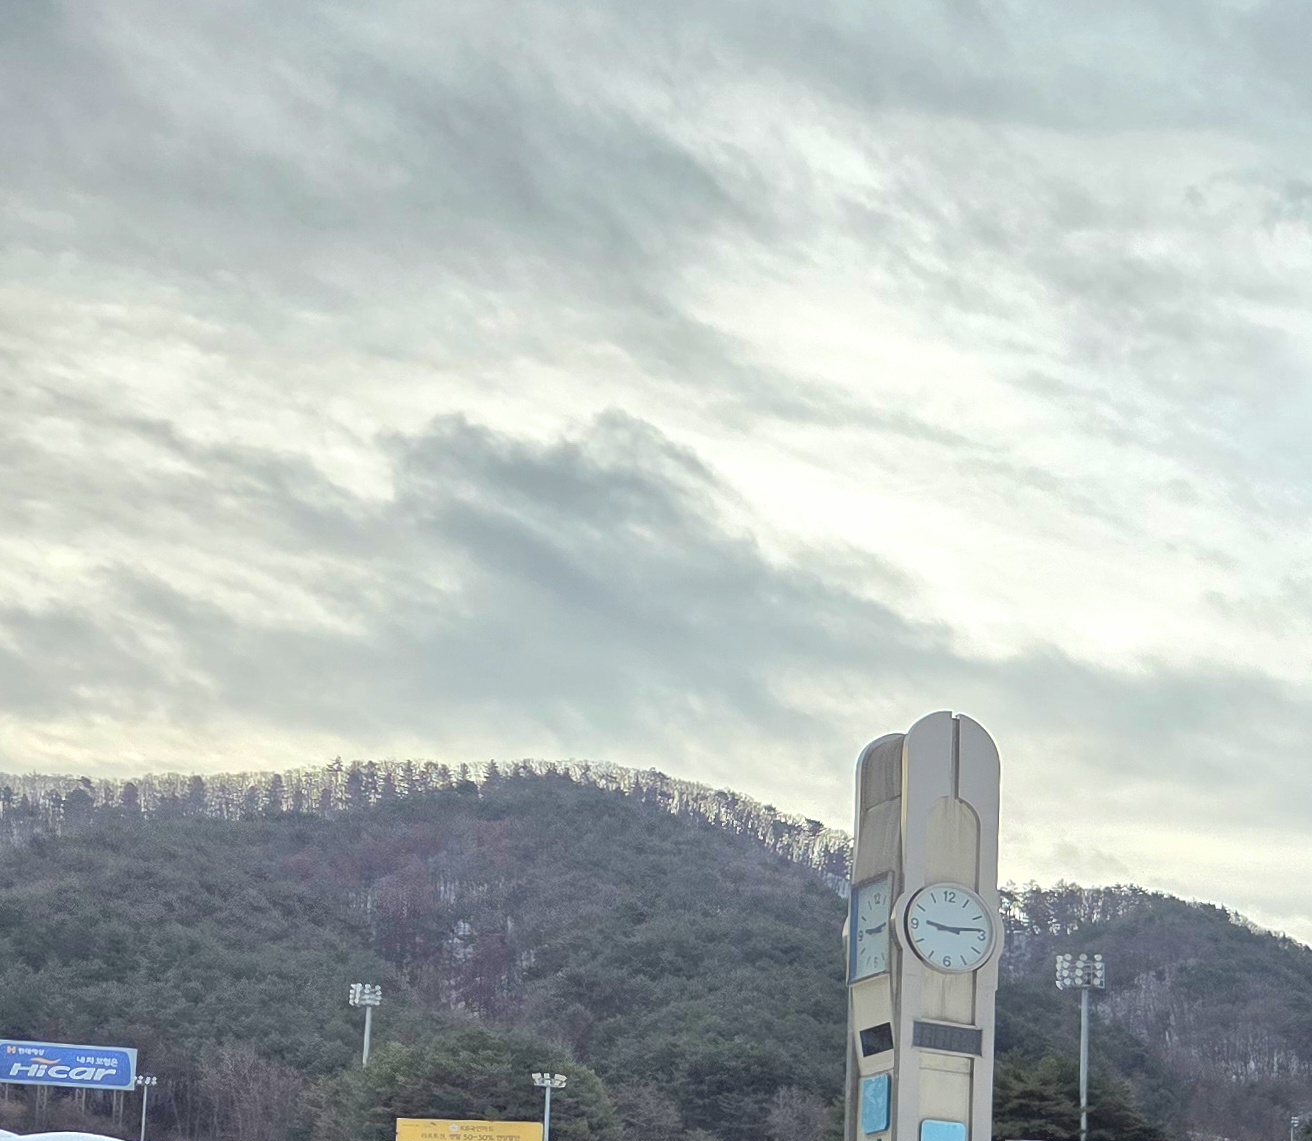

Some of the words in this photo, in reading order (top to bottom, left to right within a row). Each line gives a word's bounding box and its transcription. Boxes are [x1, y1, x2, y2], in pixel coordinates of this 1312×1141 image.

[943, 890, 956, 903] 12
[911, 917, 920, 929] 9
[943, 955, 952, 967] 6
[9, 1062, 117, 1081] Hicar
